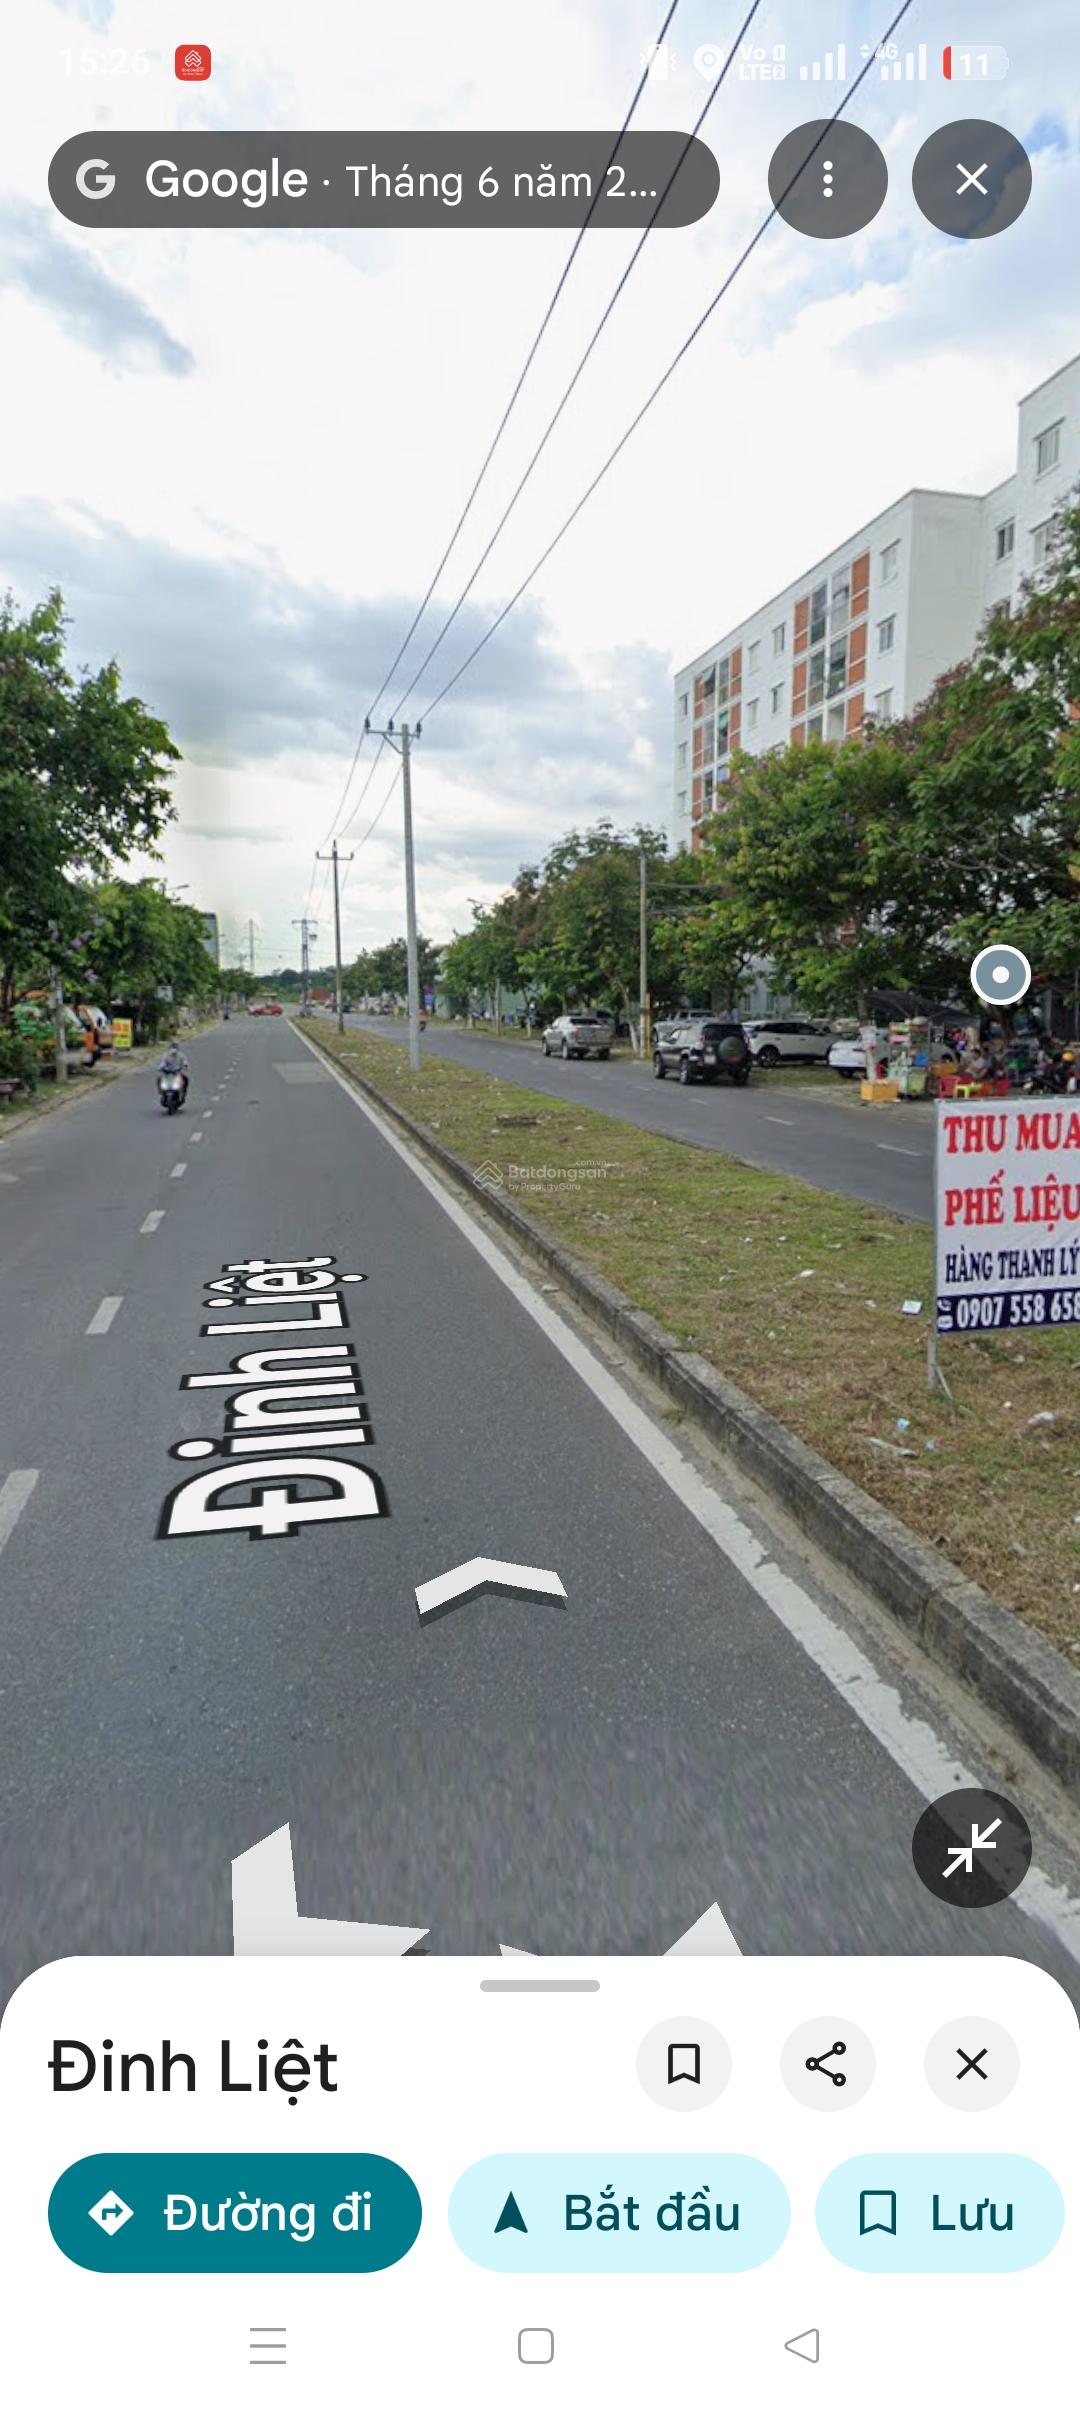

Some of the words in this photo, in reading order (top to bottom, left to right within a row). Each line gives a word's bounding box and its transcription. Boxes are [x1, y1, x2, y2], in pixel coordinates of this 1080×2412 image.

[943, 1114, 1008, 1153] THU
[1015, 1112, 1080, 1151] MUA
[945, 1168, 1005, 1226] PHẾ
[1013, 1172, 1080, 1233] LIỆU
[945, 1244, 993, 1283] HÀNG
[998, 1247, 1054, 1280] THANH
[1060, 1238, 1080, 1275] LÝ
[957, 1295, 1005, 1329] 0907
[1009, 1293, 1045, 1325] 558
